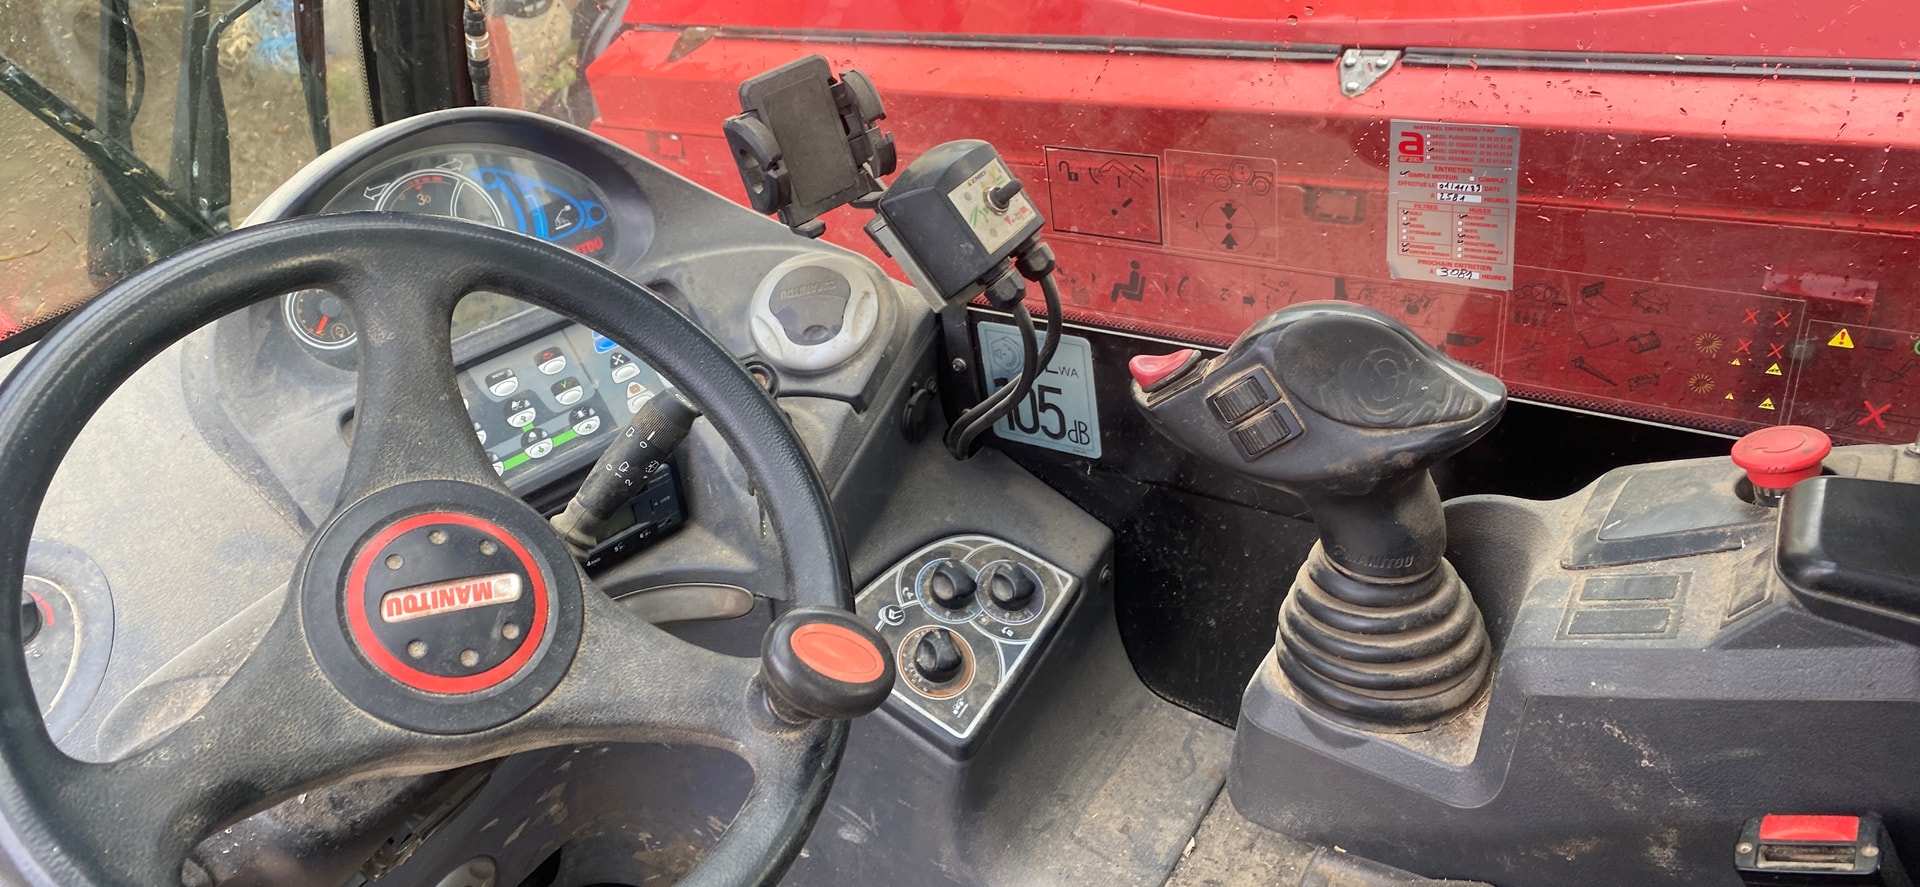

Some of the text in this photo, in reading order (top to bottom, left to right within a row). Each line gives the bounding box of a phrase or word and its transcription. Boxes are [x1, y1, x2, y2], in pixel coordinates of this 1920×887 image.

[1434, 165, 1474, 174] ENTRETIEN
[1408, 172, 1431, 180] SIMPLE
[1469, 207, 1491, 215] HUILES
[1418, 259, 1493, 272] PROCHAIN ENTRETIEN
[1481, 273, 1507, 281] HEURES
[1067, 419, 1091, 446] dB
[386, 580, 494, 618] MANITOU
